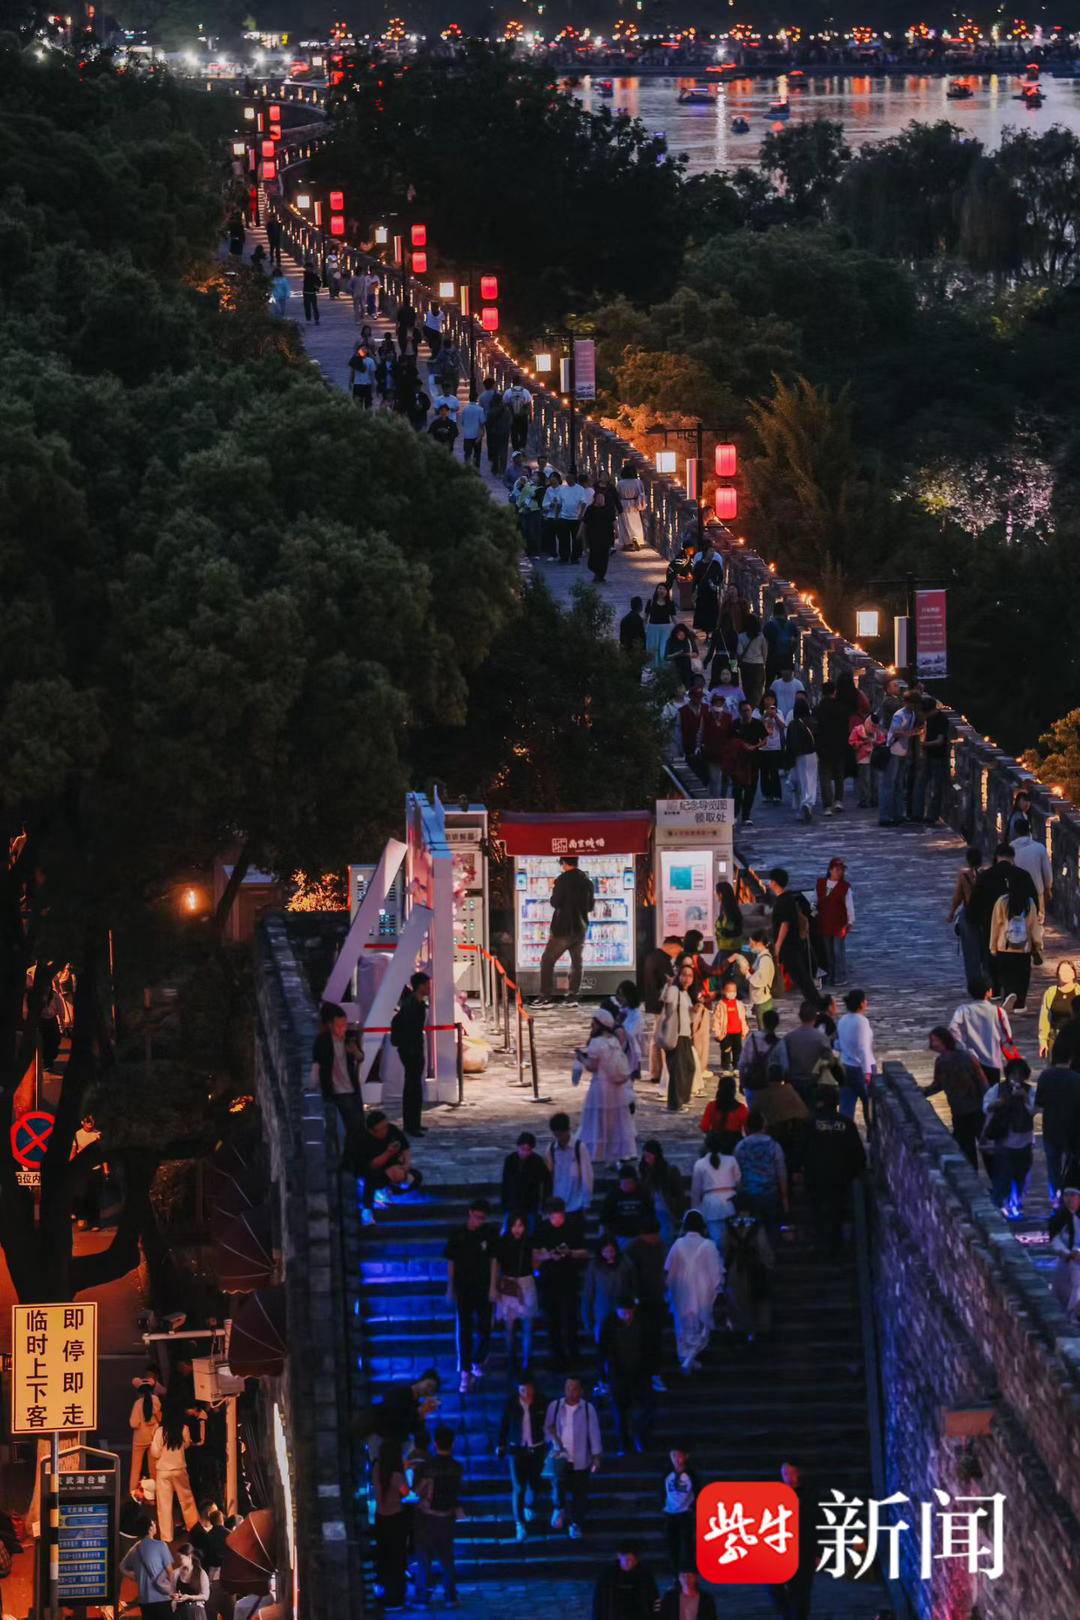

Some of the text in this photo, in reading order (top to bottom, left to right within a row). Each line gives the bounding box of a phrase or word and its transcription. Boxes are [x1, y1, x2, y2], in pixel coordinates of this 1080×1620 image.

[679, 799, 728, 811] 纪念导览图
[695, 811, 727, 824] 领取处
[26, 1308, 49, 1428] 临时上下客
[62, 1307, 85, 1426] 即停即走
[59, 1474, 107, 1485] 武湖台城
